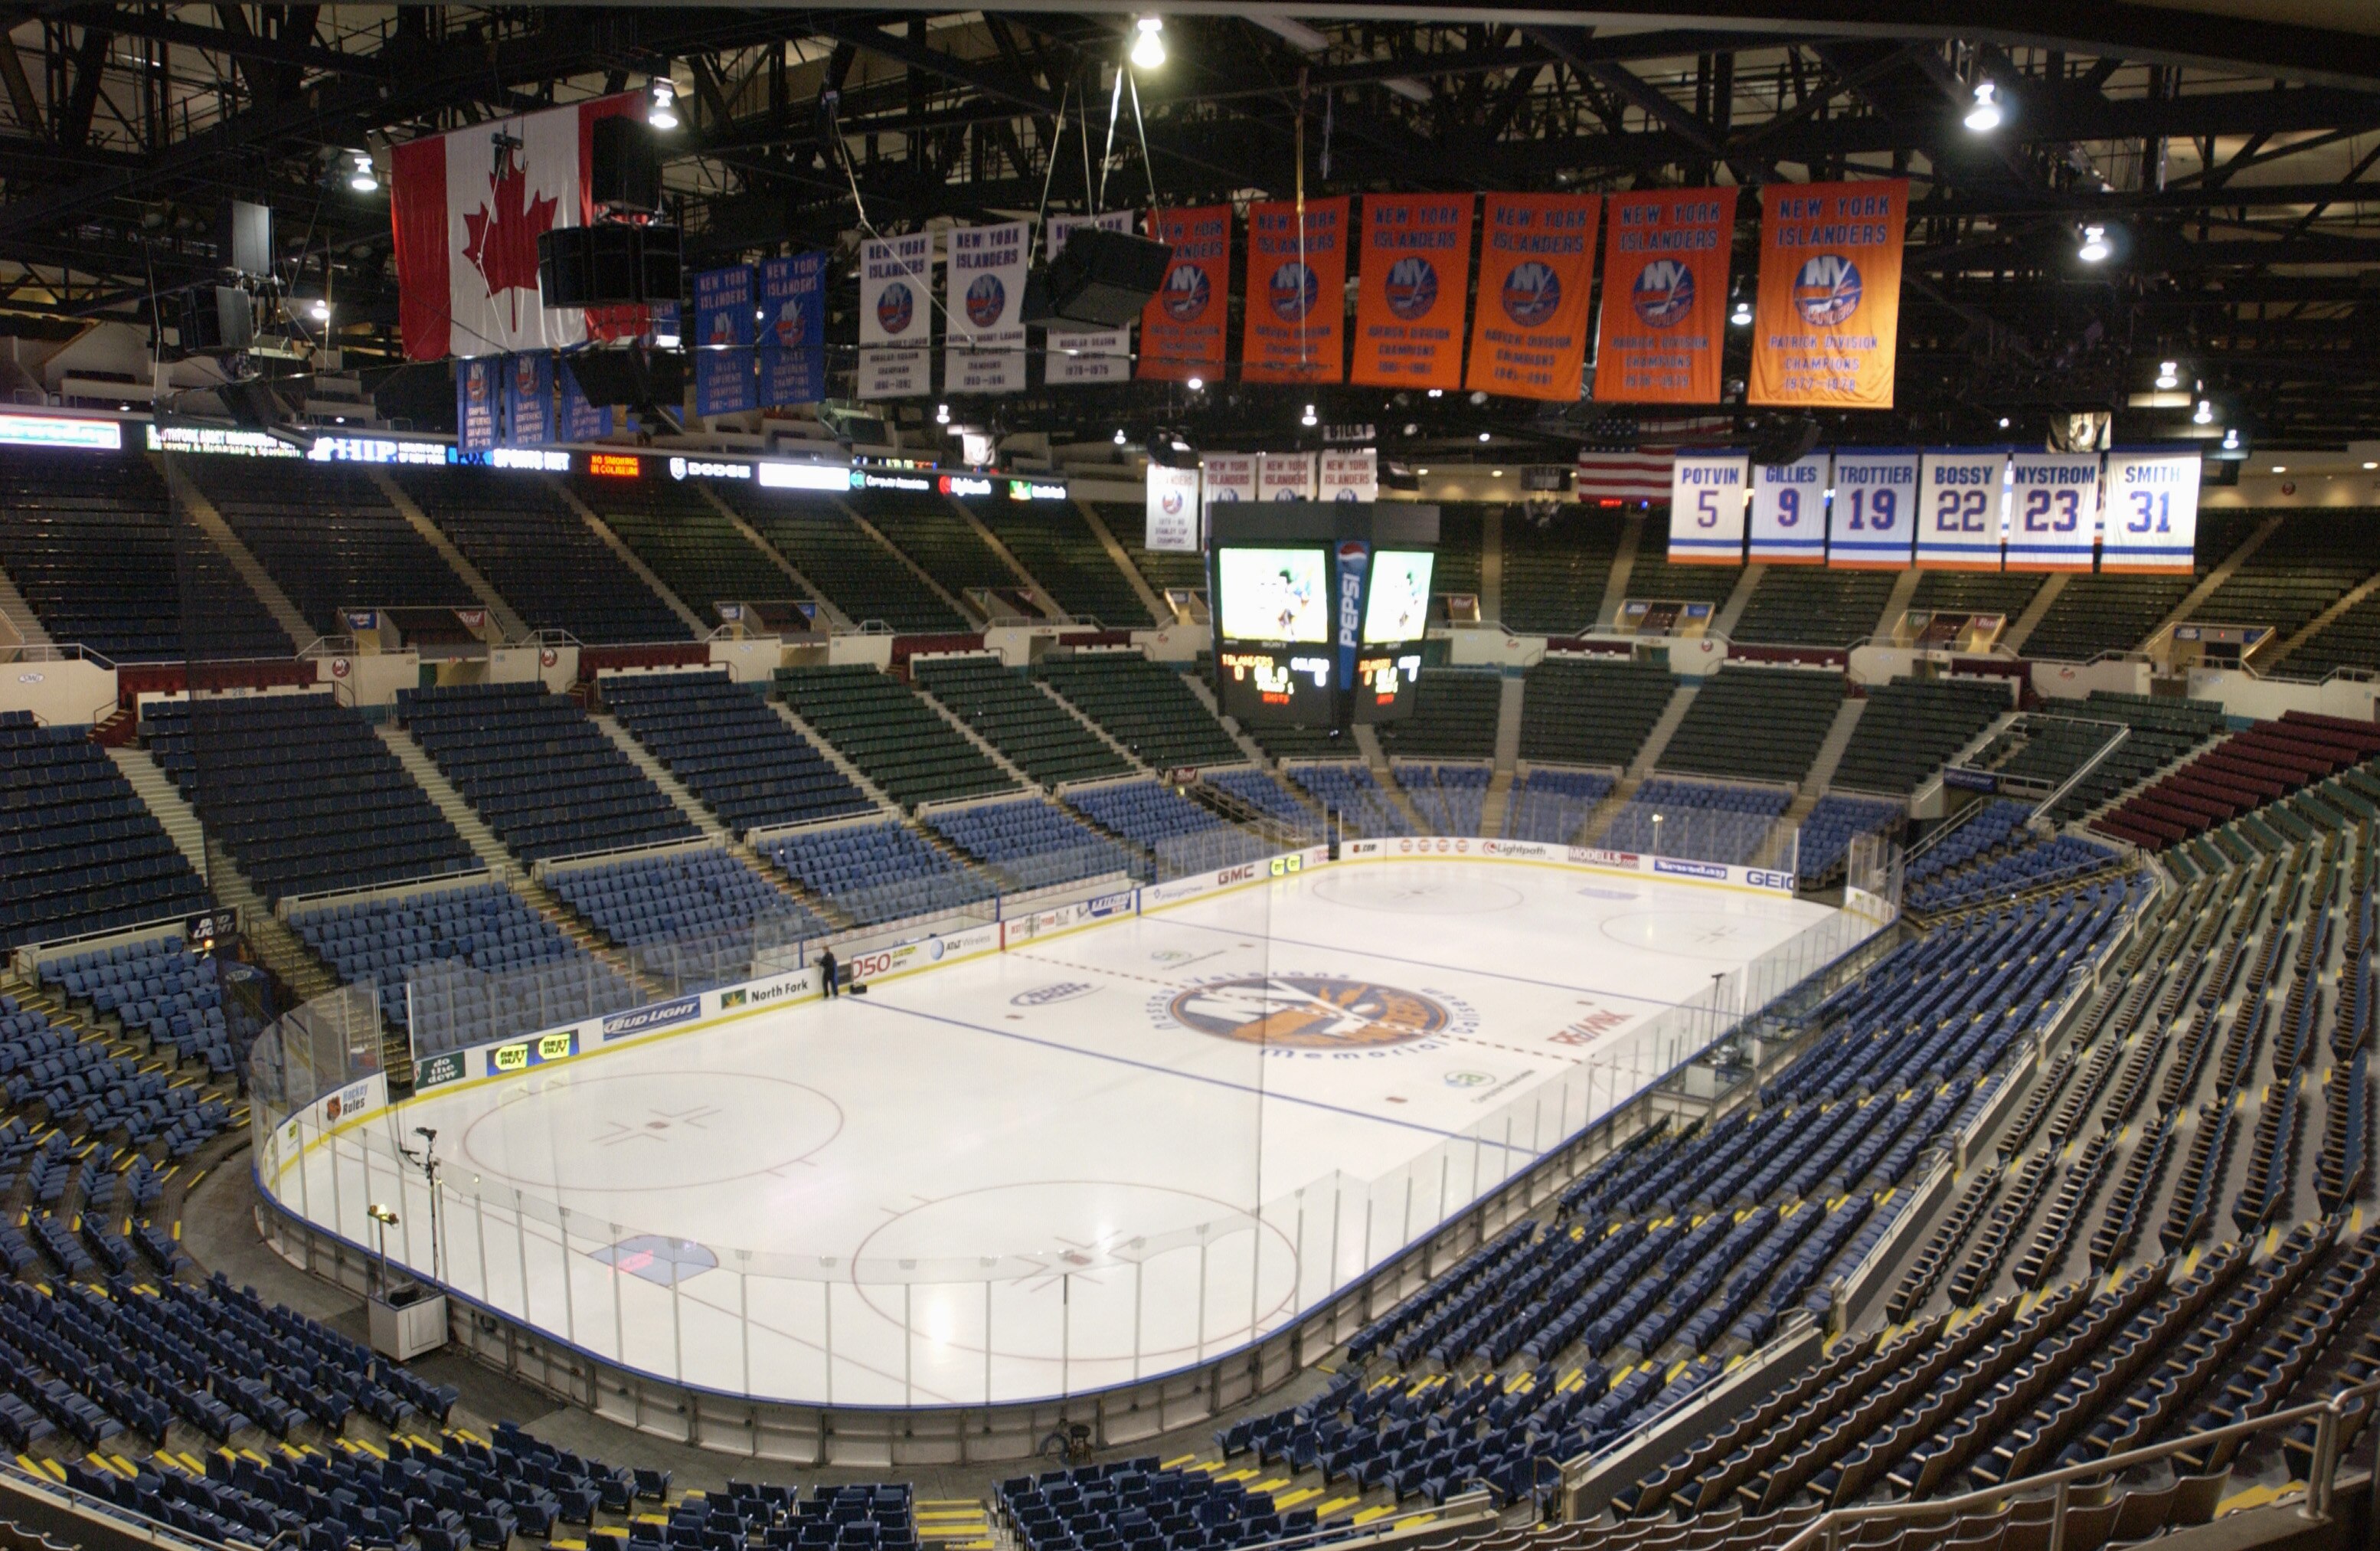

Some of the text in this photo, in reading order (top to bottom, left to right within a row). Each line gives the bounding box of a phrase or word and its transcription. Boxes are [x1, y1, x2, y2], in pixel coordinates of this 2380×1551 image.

[1375, 208, 1458, 224] NEW YORK
[1622, 202, 1720, 226] NEW YORK
[1778, 195, 1890, 220] NEW YORK
[1258, 214, 1288, 230] NEW
[1496, 206, 1587, 227] NEW YORK
[957, 228, 1018, 249] NEW YORK
[1156, 221, 1224, 239] NEW YORK
[1777, 224, 1887, 247] ISLANDERS
[1258, 234, 1334, 254] ISLANDERS
[1374, 231, 1456, 250] ISLANDERS
[1493, 231, 1584, 254] ISLANDERS
[1620, 229, 1717, 251] ISLANDERS
[868, 238, 926, 260] NEW YORK
[767, 257, 818, 278] NEW YORK
[956, 249, 1018, 269] ISLANDERS
[869, 259, 924, 280] ISLANDERS
[700, 270, 747, 292] NEW YORK
[767, 276, 817, 296] ISLANDERS
[701, 289, 747, 310] ISLANDERS
[1091, 337, 1116, 346] SEASON
[1378, 345, 1434, 355] CHAMPIONS
[1527, 335, 1571, 348] DIVISION
[1612, 336, 1708, 350] PATRICK DIVISION
[1770, 335, 1878, 349] PATRICK DIVISION
[1497, 350, 1555, 367] CHAMPIONS
[1625, 355, 1691, 368] CHAMPIONS
[1785, 358, 1859, 371] CHAMPIONS
[516, 411, 542, 422] CONFERENCE
[591, 456, 637, 466] NO SMOKING
[1209, 460, 1249, 471] NEW YORK
[1267, 461, 1307, 471] NEW YORK
[1326, 460, 1368, 470] NEW YORK
[591, 465, 639, 476] IN COLISEUM
[688, 462, 751, 479] DODGE
[1682, 468, 1739, 484] POTVIN
[1766, 466, 1816, 483] GILLIES
[1839, 466, 1913, 484] TROTTIER
[1934, 466, 1993, 485] BOSSY
[2015, 466, 2096, 485] NYSTROM
[2125, 466, 2181, 483] SMITH
[1208, 474, 1250, 485] ISLANDERS
[1265, 474, 1308, 485] ISLANDERS
[1325, 474, 1370, 485] ISLANDERS
[1698, 489, 1719, 528] 5
[1777, 488, 1800, 527] 9
[1849, 488, 1896, 530] 19
[1937, 489, 1987, 532] 22
[2025, 489, 2080, 532] 23
[2127, 490, 2171, 533] 31
[459, 614, 481, 623] Bud
[1340, 572, 1361, 649] PEPSI
[1497, 843, 1545, 856] Lightpath
[1218, 865, 1254, 885] GMC
[1656, 860, 1727, 879] Newsday
[963, 934, 990, 947] Wireless
[1184, 970, 1351, 986] Veterans
[752, 980, 808, 1002] North Fork
[609, 1003, 697, 1032] BUD LIGHT
[544, 1039, 568, 1049] BEST
[544, 1045, 567, 1054] BUY
[500, 1049, 527, 1059] BEST
[501, 1056, 523, 1065] BUY
[431, 1064, 455, 1076] the
[433, 1058, 450, 1070] do
[427, 1070, 458, 1085] dew
[343, 1083, 369, 1102] Hockey
[343, 1098, 365, 1116] Rules
